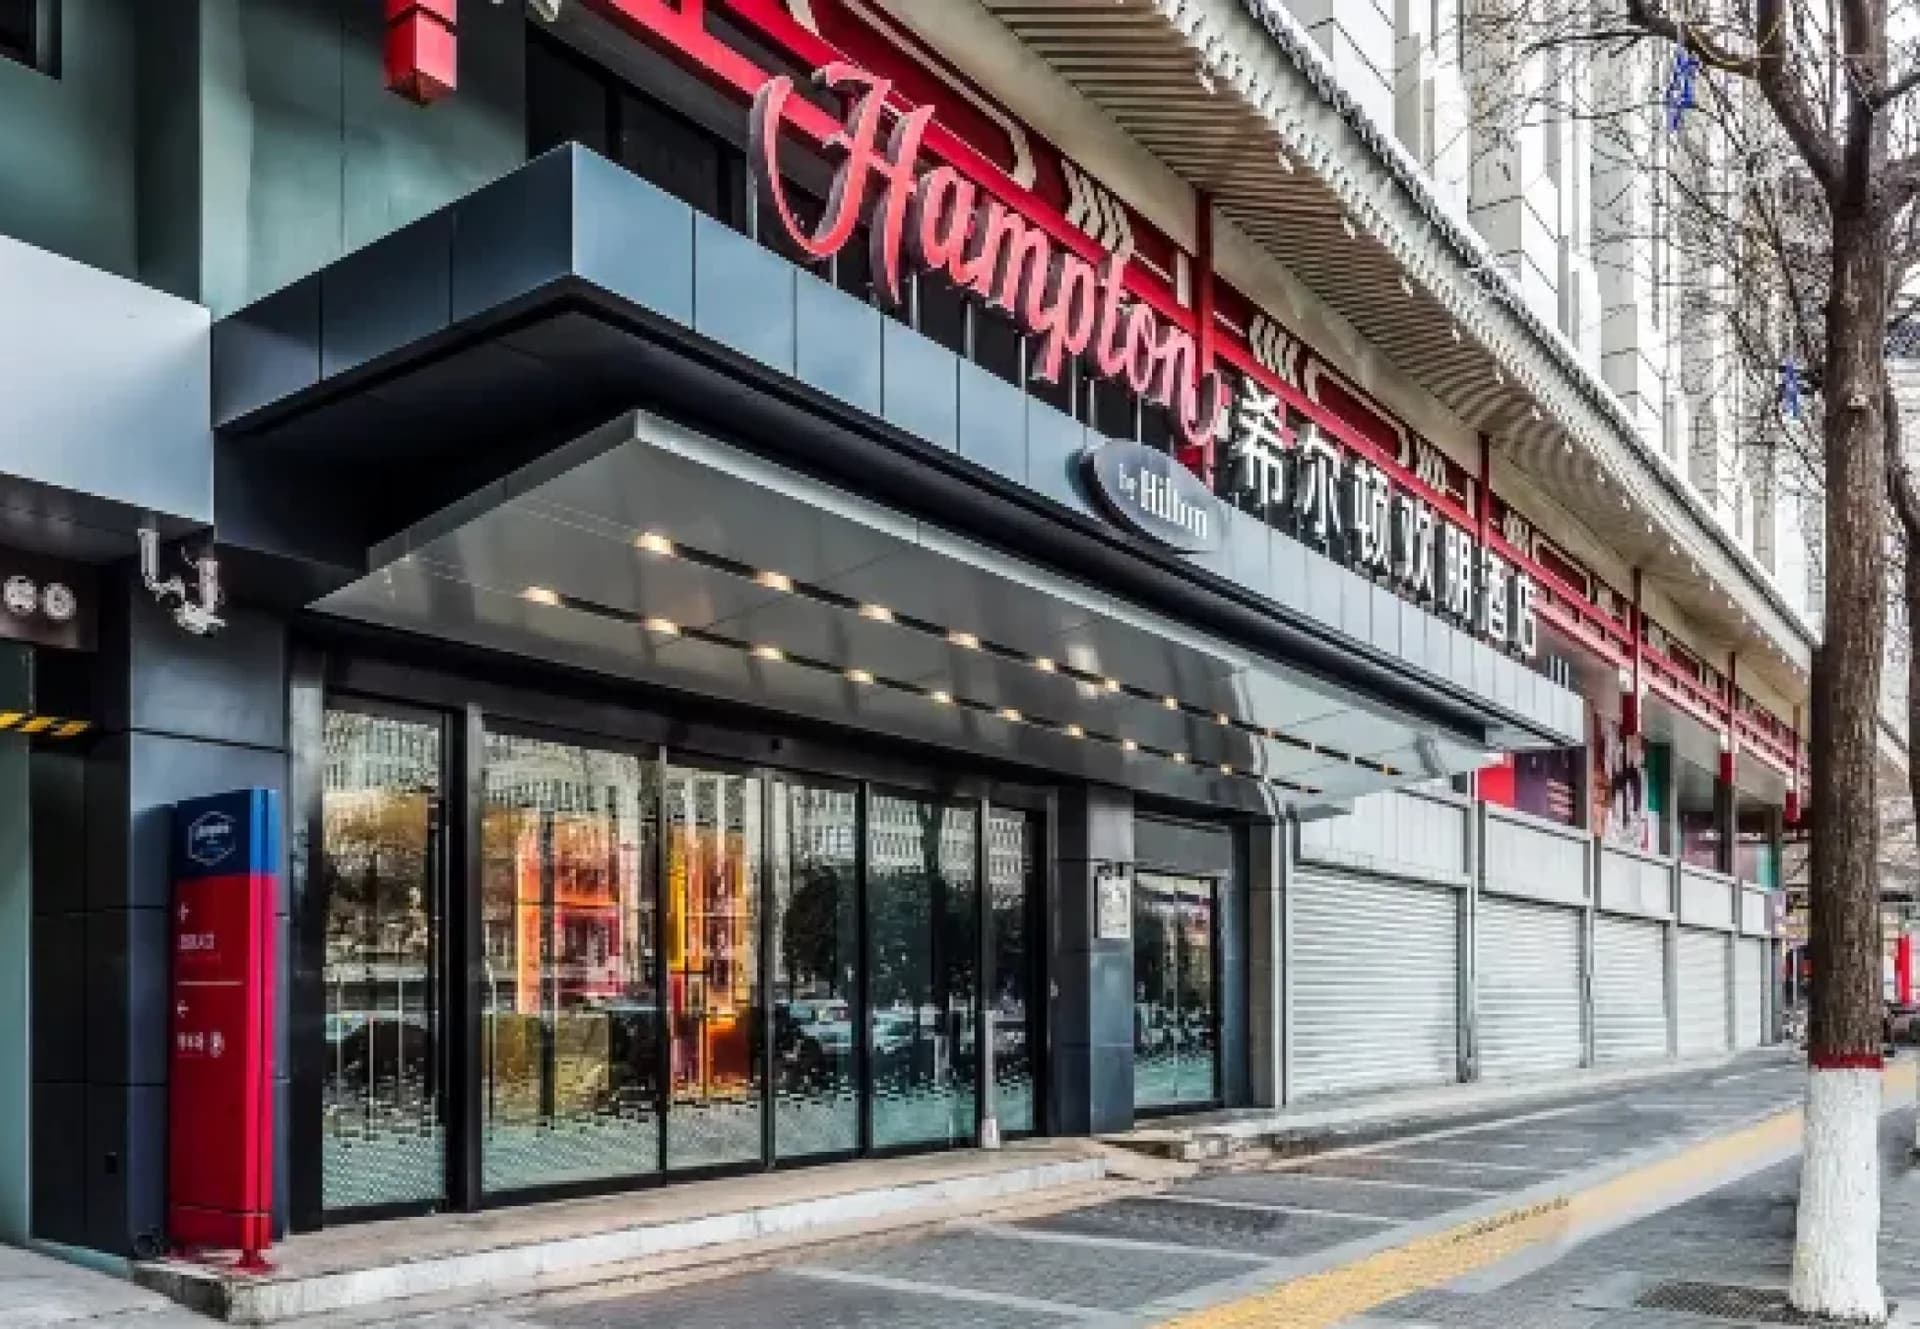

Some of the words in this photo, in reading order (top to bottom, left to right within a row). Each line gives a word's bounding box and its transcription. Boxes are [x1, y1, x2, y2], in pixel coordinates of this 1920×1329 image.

[752, 60, 1227, 446] Hampton
[1140, 466, 1207, 540] Hilton
[1231, 375, 1538, 657] 希尔顿欢朋酒店
